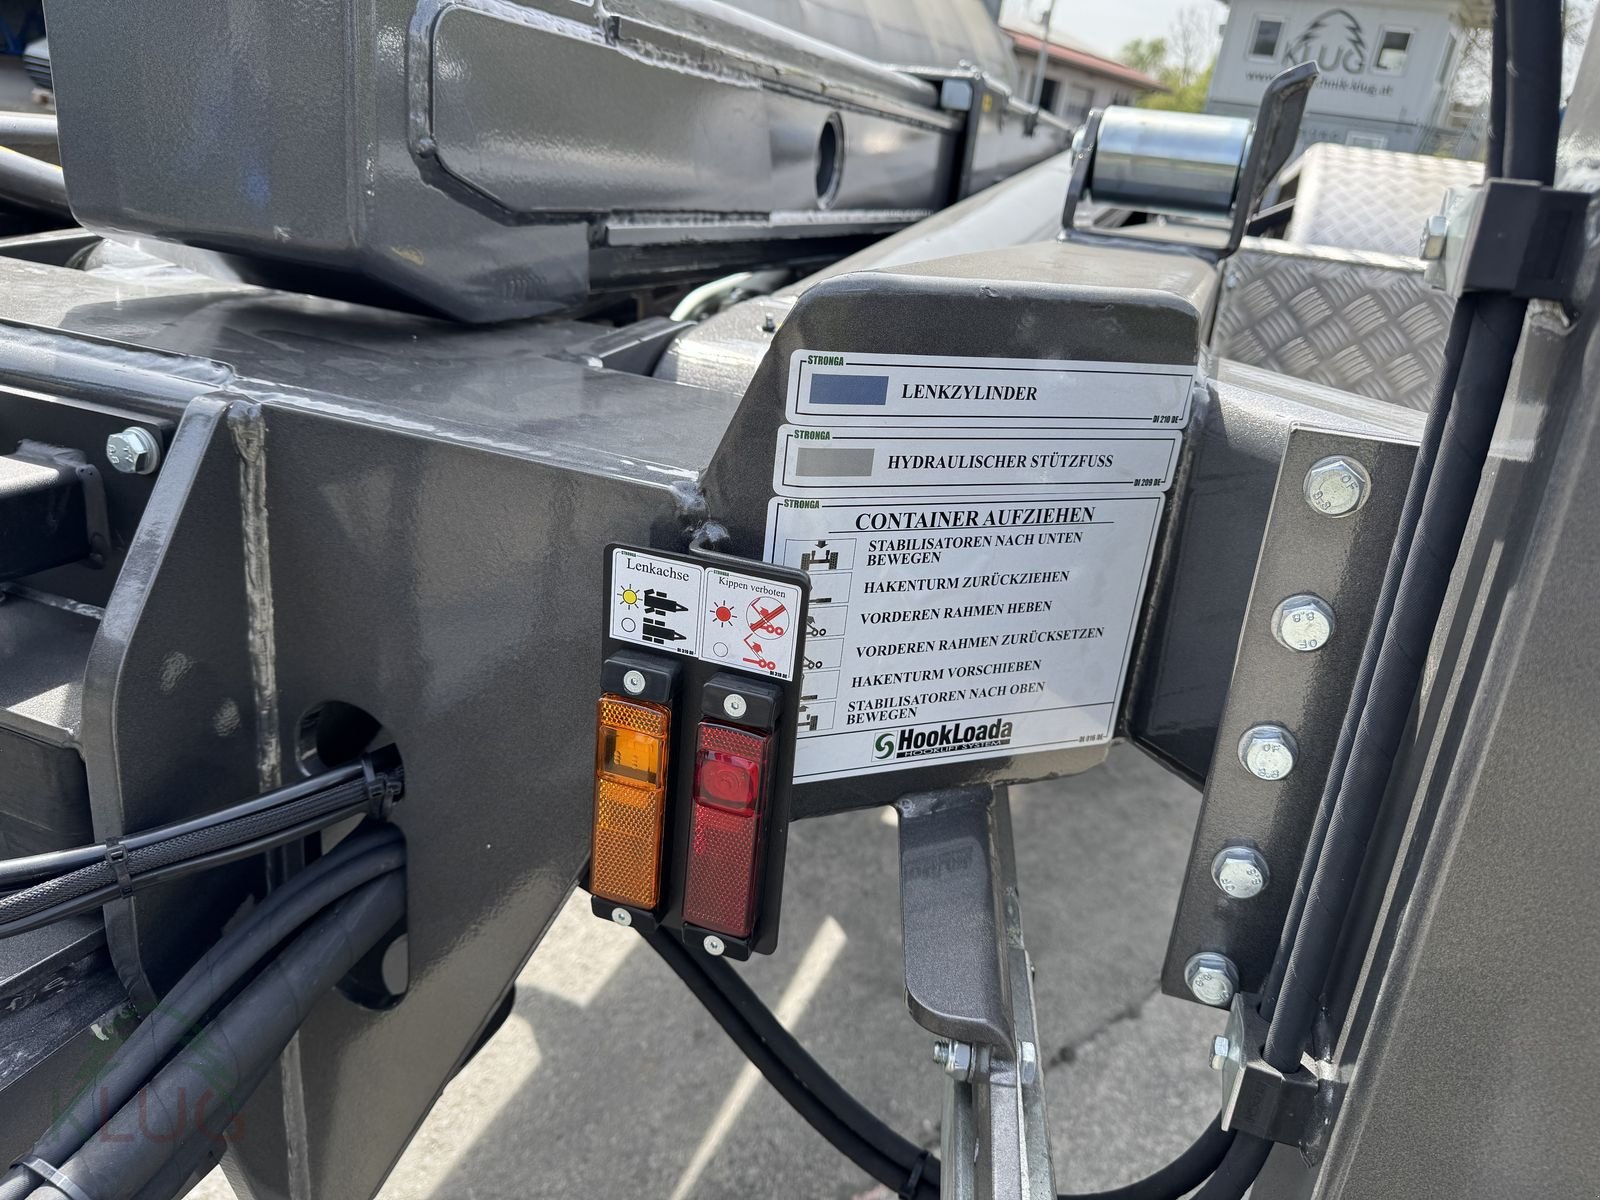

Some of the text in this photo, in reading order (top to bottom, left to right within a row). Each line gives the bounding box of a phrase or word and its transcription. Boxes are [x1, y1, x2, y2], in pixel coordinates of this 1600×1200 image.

[807, 355, 844, 366] STRONGA
[901, 383, 1038, 401] LENKZYLINDER
[1160, 415, 1171, 424] 210
[794, 430, 831, 441] STRONGA
[887, 452, 1114, 469] HYDRAULISCHER STÜTZFUSS
[784, 498, 820, 509] STRONGA
[855, 506, 1096, 531] CONTAINER AUFZIEHEN
[868, 532, 1083, 552] STABILISATOREN NACH UNTEN
[626, 558, 690, 581] Lenkachse
[867, 552, 942, 567] BEWEGEN
[719, 576, 786, 598] Kippen verboten
[864, 571, 1070, 594] HAKENTURM ZURÜCKZIEHEN
[861, 601, 1053, 625] VORDEREN RAHMEN HEBEN
[856, 627, 1105, 658] VORDEREN RAHMEN ZURÜCKSETZEN
[851, 660, 1042, 688] HAKENTURM VORSCHIEBEN
[848, 681, 1046, 712] STABILISATOREN NACH OBEN
[846, 707, 918, 725] BEWEGEN
[898, 718, 1013, 750] HookLoada
[905, 745, 958, 757] HOOKLIFT
